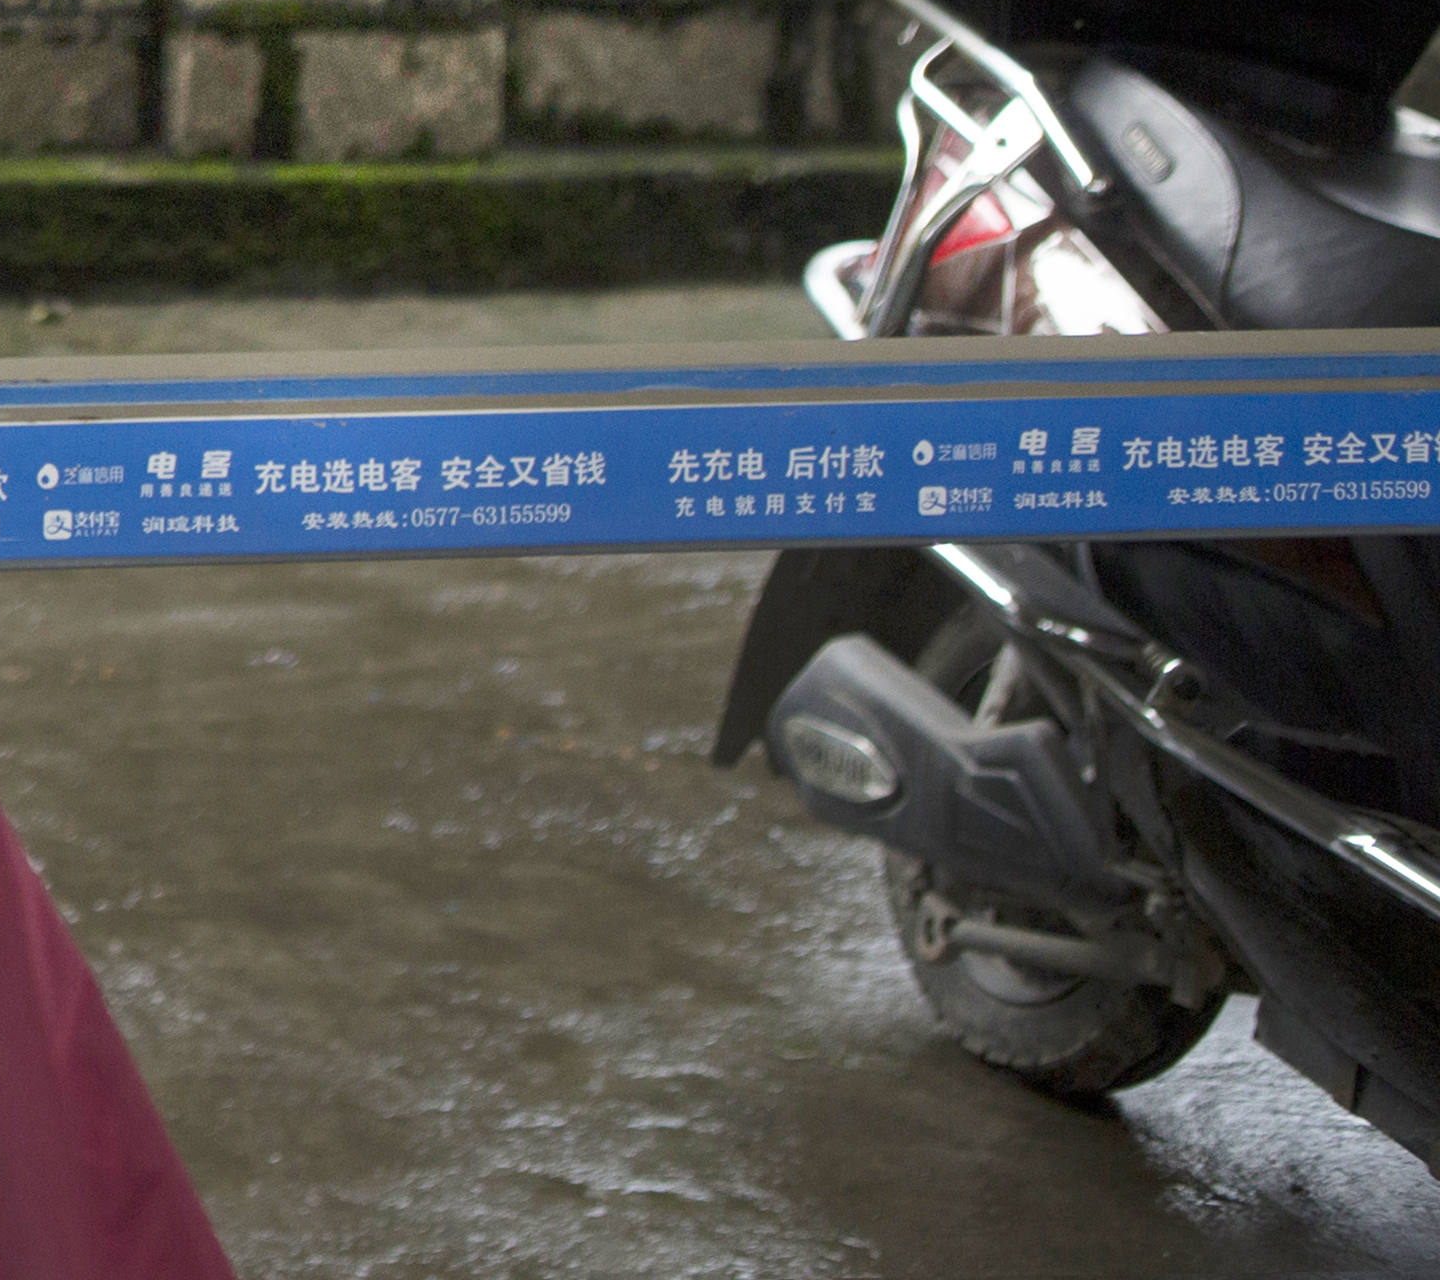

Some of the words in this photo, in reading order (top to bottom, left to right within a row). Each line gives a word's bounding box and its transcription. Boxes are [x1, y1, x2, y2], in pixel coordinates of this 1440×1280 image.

[668, 448, 767, 484] 先充电
[785, 444, 885, 480] 后付款
[938, 442, 998, 462] 芝麻信用
[1122, 434, 1285, 471] 充电选电客
[254, 458, 423, 495] 充电选电客
[440, 451, 606, 490] 安全又省钱
[675, 491, 877, 518] 充电就用支付宝
[948, 487, 993, 505] 支付宝
[74, 510, 121, 529] 支付宝
